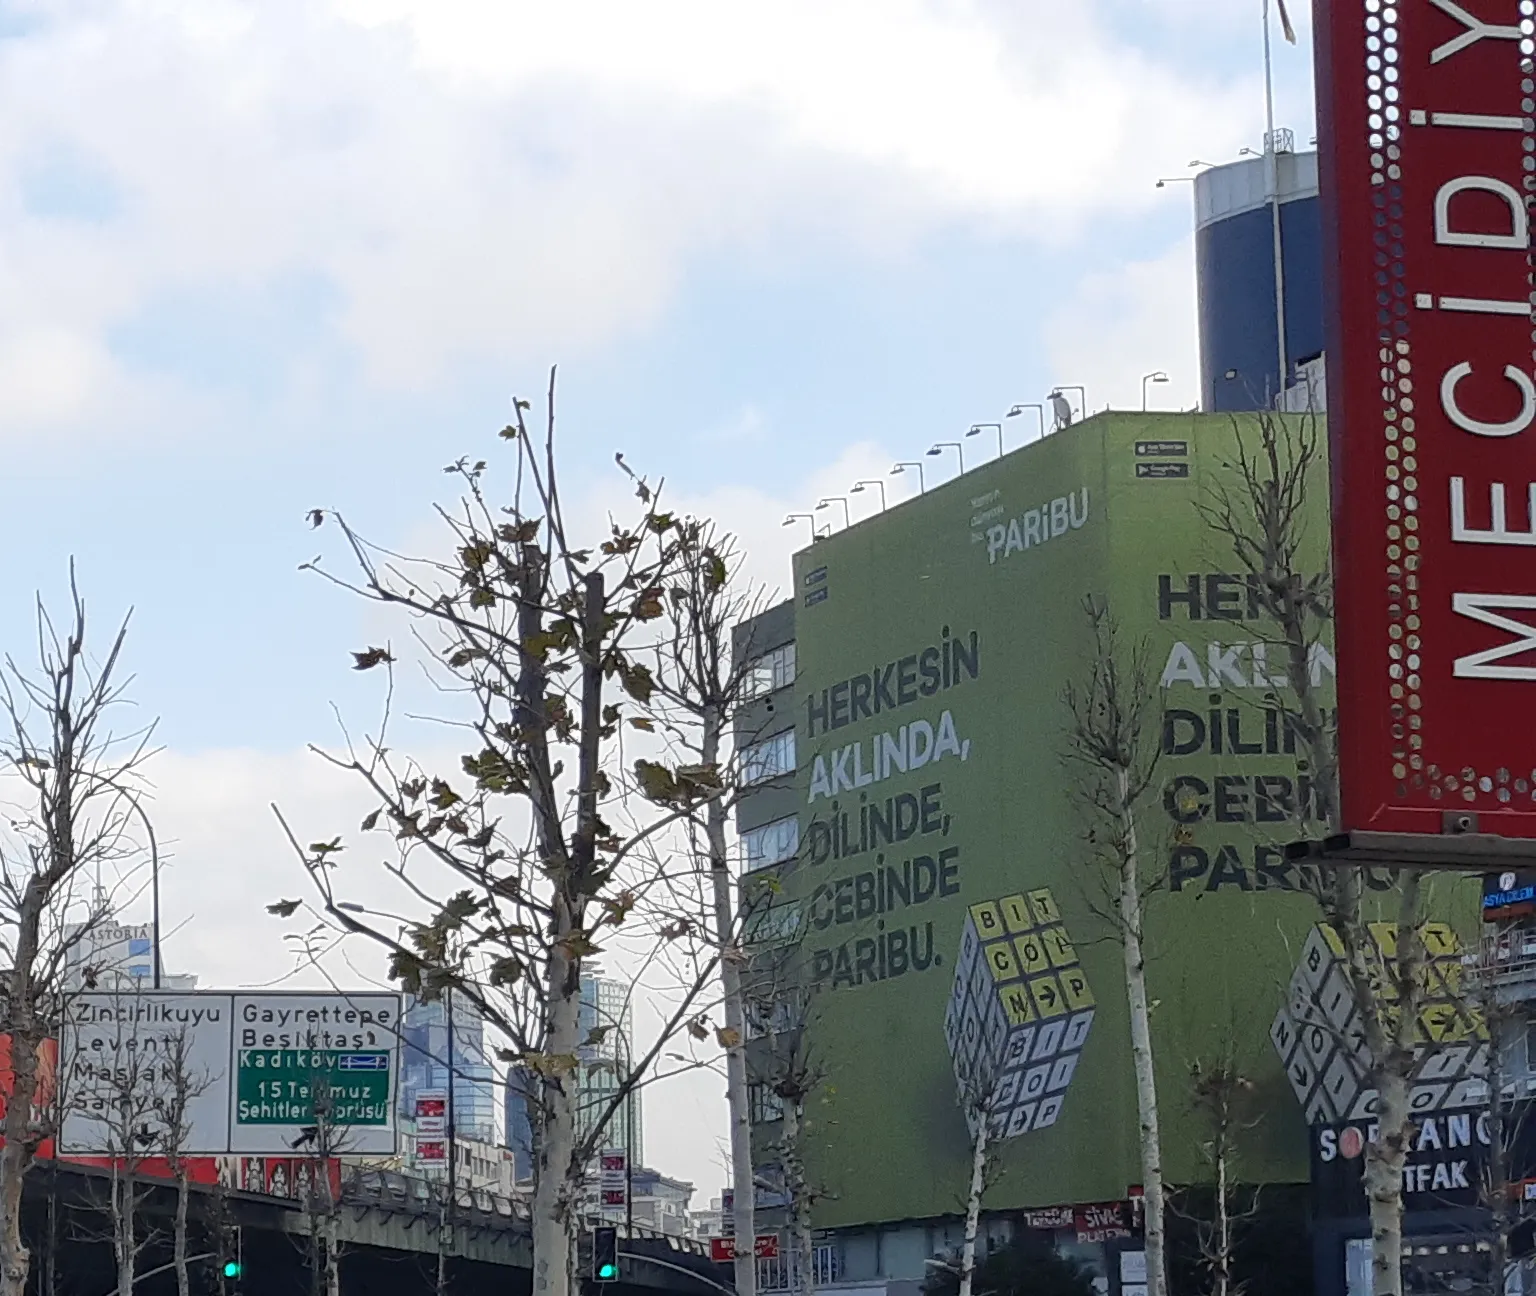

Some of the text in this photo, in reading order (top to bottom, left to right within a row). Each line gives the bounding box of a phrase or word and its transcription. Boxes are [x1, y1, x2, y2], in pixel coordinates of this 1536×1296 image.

[807, 624, 978, 738] HERKESİN
[807, 708, 972, 804] AKLINDA,
[809, 781, 951, 867] DİLİNDE,
[811, 845, 961, 931] CEBİNDE
[75, 1002, 391, 1029] Zincirlikuyu Gayrettepe
[242, 1028, 365, 1051] Beşiktaş
[73, 1050, 336, 1083] Maslak Kadıköy
[73, 1090, 387, 1120] Saryer Şehitler prüsü
[258, 1081, 282, 1099] 15
